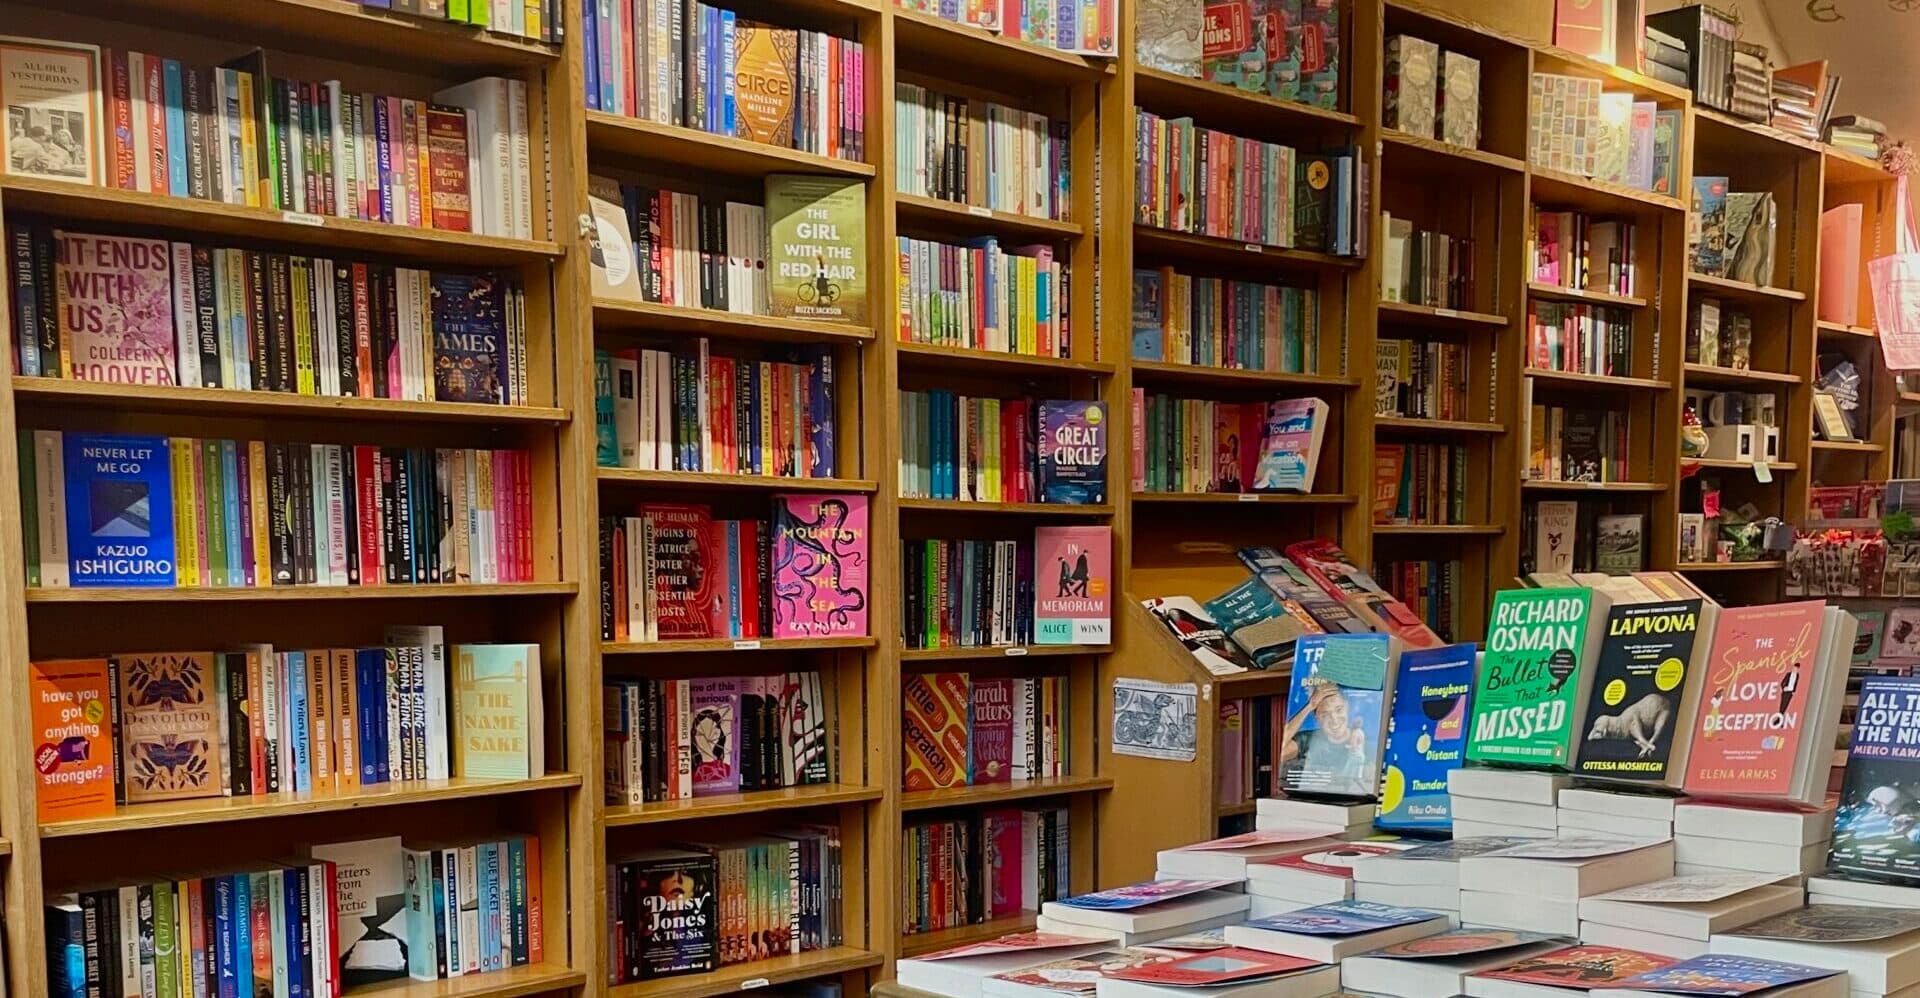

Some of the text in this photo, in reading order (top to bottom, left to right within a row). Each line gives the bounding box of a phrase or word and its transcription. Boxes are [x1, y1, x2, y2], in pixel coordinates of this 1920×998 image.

[724, 20, 735, 96] THE FORTUNE MEN
[24, 62, 67, 74] ALL OUR
[11, 71, 80, 85] YESTERDAYS
[736, 73, 790, 96] CIRCE
[741, 92, 784, 106] MADELINE
[118, 100, 128, 132] GROFF
[747, 104, 777, 116] MILLER
[378, 110, 392, 212] LAUREN GROFF MATRIX
[500, 156, 509, 169] US
[520, 158, 528, 170] US
[406, 158, 418, 192] Love
[806, 208, 828, 220] THE
[640, 212, 650, 256] ELMET
[796, 223, 840, 240] GIRL
[17, 231, 30, 259] THIS
[784, 244, 852, 258] WITH THE
[64, 237, 167, 272] IT ENDS
[20, 261, 32, 288] GIRL
[780, 262, 856, 280] RED HAIR
[64, 270, 136, 304] WITH
[178, 248, 192, 314] WITHOUT MERIT
[23, 306, 34, 334] COLLEEN
[67, 304, 104, 333] US
[356, 280, 368, 348] THE MERCIES
[90, 346, 152, 362] COLLEEN
[72, 363, 170, 385] HOOVER
[342, 355, 352, 378] SONG
[1038, 406, 1048, 465] GREAT CIRCLE
[1270, 422, 1305, 433] You and
[1056, 426, 1098, 446] GREAT
[84, 448, 152, 460] NEVER LET
[1054, 447, 1100, 466] CIRCLE
[97, 462, 141, 474] ME GO
[331, 462, 342, 497] PROPHETS
[667, 512, 699, 523] HUMAN
[808, 504, 839, 515] THE
[1543, 516, 1569, 527] KING
[646, 524, 654, 557] ORHAN
[686, 528, 699, 538] OF
[782, 527, 862, 540] MOUNTAIN
[402, 524, 410, 561] INDIANS
[1067, 543, 1079, 555] IN
[97, 545, 148, 557] KAZUO
[816, 553, 832, 565] IN
[75, 560, 172, 574] ISHIGURO
[658, 575, 688, 586] OTHER
[811, 576, 838, 589] THE
[810, 601, 836, 613] SEA
[1042, 600, 1104, 612] MEMORIAM
[1225, 590, 1252, 608] ALL THE
[1235, 602, 1256, 616] LIGHT
[789, 622, 812, 632] RAY
[1042, 624, 1104, 634] ALICE WINN
[1610, 613, 1696, 636] LAPVONA
[1492, 626, 1578, 653] OSMAN
[1755, 638, 1774, 649] THE
[1500, 654, 1516, 665] The
[1713, 622, 1813, 685] Spanish
[1486, 658, 1548, 692] Bullet
[42, 690, 99, 704] have you
[976, 681, 1007, 702] arah
[1422, 684, 1468, 699] Honeybees
[1514, 686, 1542, 702] That
[1730, 682, 1779, 700] LOVE
[478, 692, 512, 708] THE
[1862, 692, 1899, 710] ALL
[61, 708, 82, 722] got
[124, 710, 210, 726] Devotion
[400, 693, 412, 729] EATING
[413, 693, 426, 728] EATING
[975, 704, 1013, 721] aters
[1860, 709, 1920, 728] LOVER
[464, 715, 520, 730] NAME
[1026, 678, 1034, 781] IRVINE WELSH
[1441, 718, 1459, 730] and
[1703, 712, 1798, 732] DECEPTION
[45, 724, 100, 739] anything
[296, 698, 307, 764] Writers Lovers
[1858, 726, 1892, 742] THE
[470, 736, 522, 752] SAKE
[904, 716, 947, 776] scratch
[1853, 745, 1920, 758] MIEKO KAWA
[1426, 750, 1459, 762] Distant
[1583, 761, 1664, 772] OTTESSA MOSHFEGH
[1700, 769, 1777, 780] ELENA ARMAS
[44, 766, 104, 784] stronger?
[1412, 779, 1448, 791] Thunder
[1425, 806, 1448, 815] Onda
[338, 868, 371, 879] etters
[488, 850, 498, 912] BLUE TICKET
[340, 900, 368, 912] rctic
[643, 892, 711, 914] Daisy
[238, 894, 249, 943] GLOAMING
[648, 913, 706, 932] Jones
[158, 922, 170, 950] LEVY
[257, 912, 266, 960] Soul Sisters
[652, 928, 704, 942] & The Six
[84, 908, 99, 982] KEISHA THE SKET
